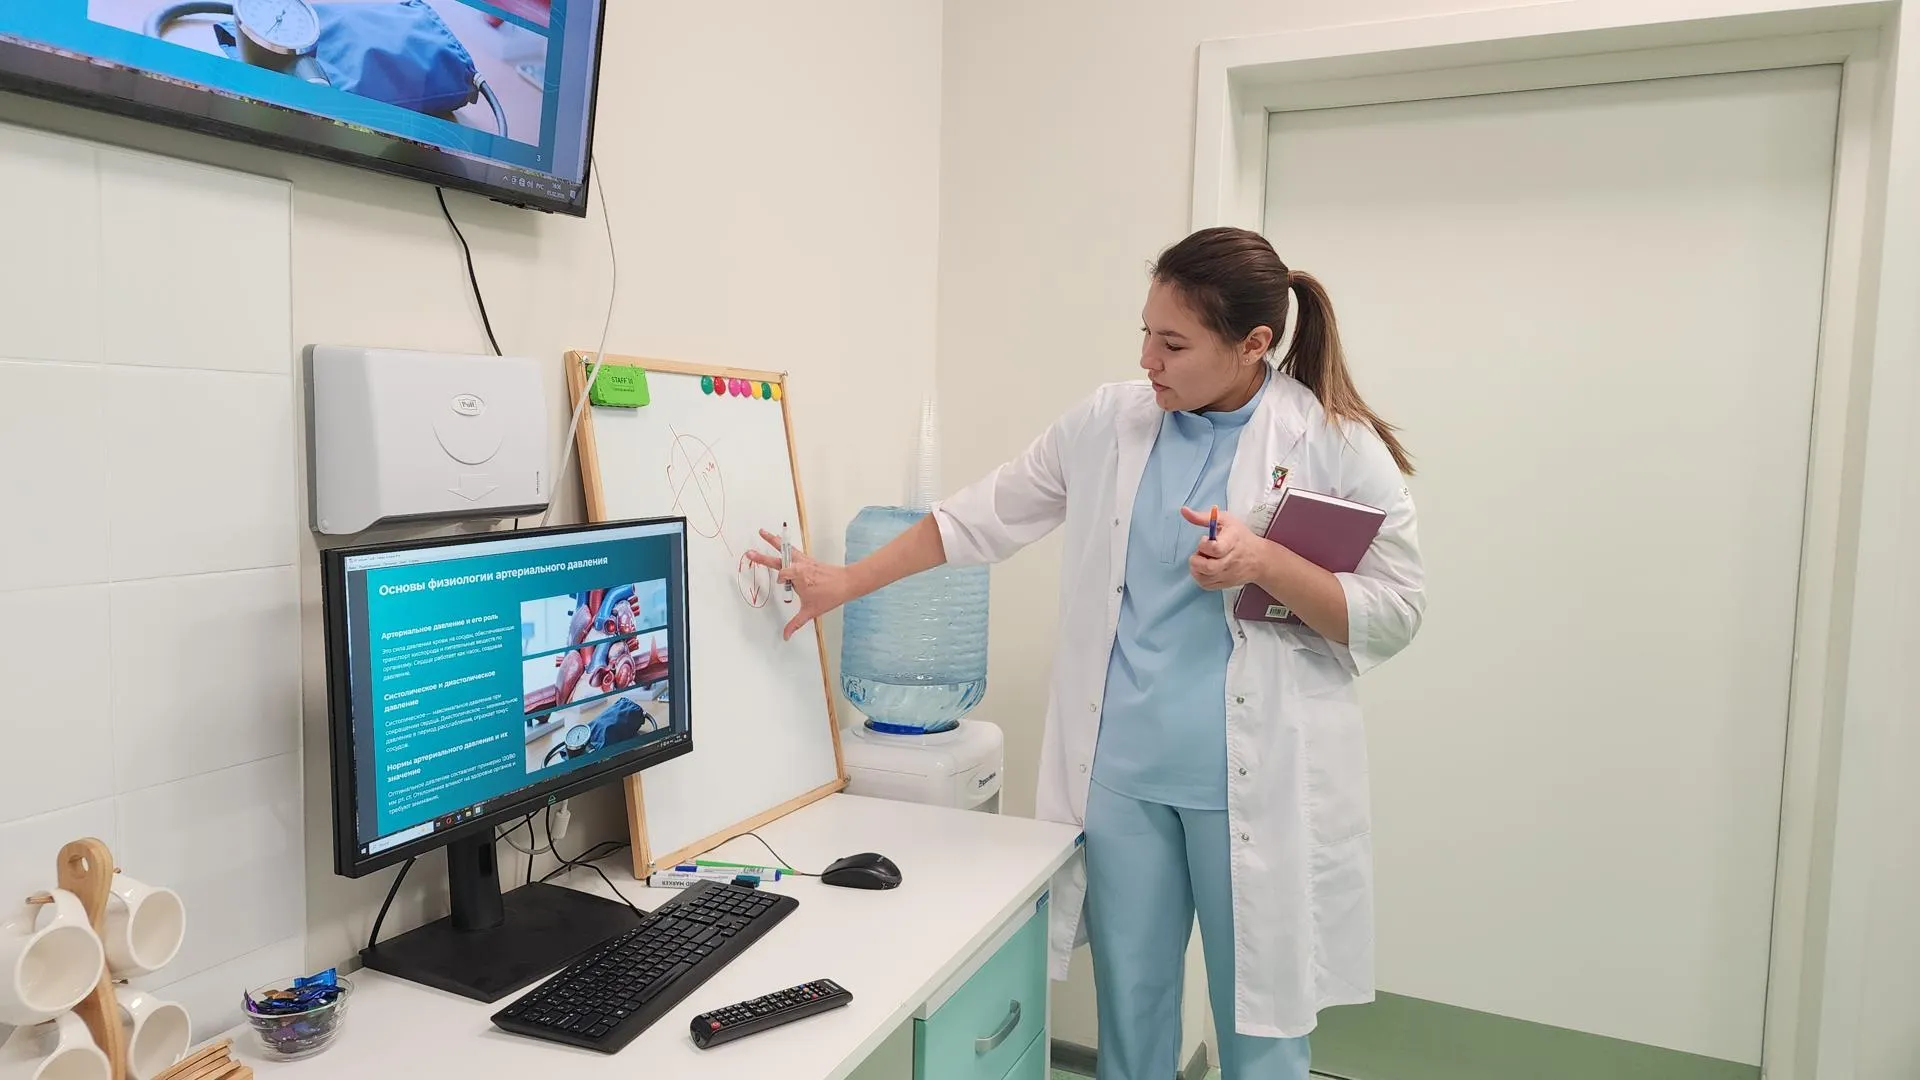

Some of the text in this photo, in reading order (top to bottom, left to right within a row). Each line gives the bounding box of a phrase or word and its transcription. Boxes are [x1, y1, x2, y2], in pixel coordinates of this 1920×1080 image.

[379, 556, 608, 596] Основы физиологии артериального давления
[381, 625, 432, 640] Артериальное
[433, 620, 465, 631] давление
[483, 614, 498, 622] роль
[384, 684, 437, 700] Систолическое
[444, 671, 495, 688] диастолическое
[384, 699, 419, 713] давление
[387, 760, 412, 771] Нормы
[413, 745, 463, 764] артериального
[464, 736, 494, 749] давления
[387, 768, 421, 782] значение
